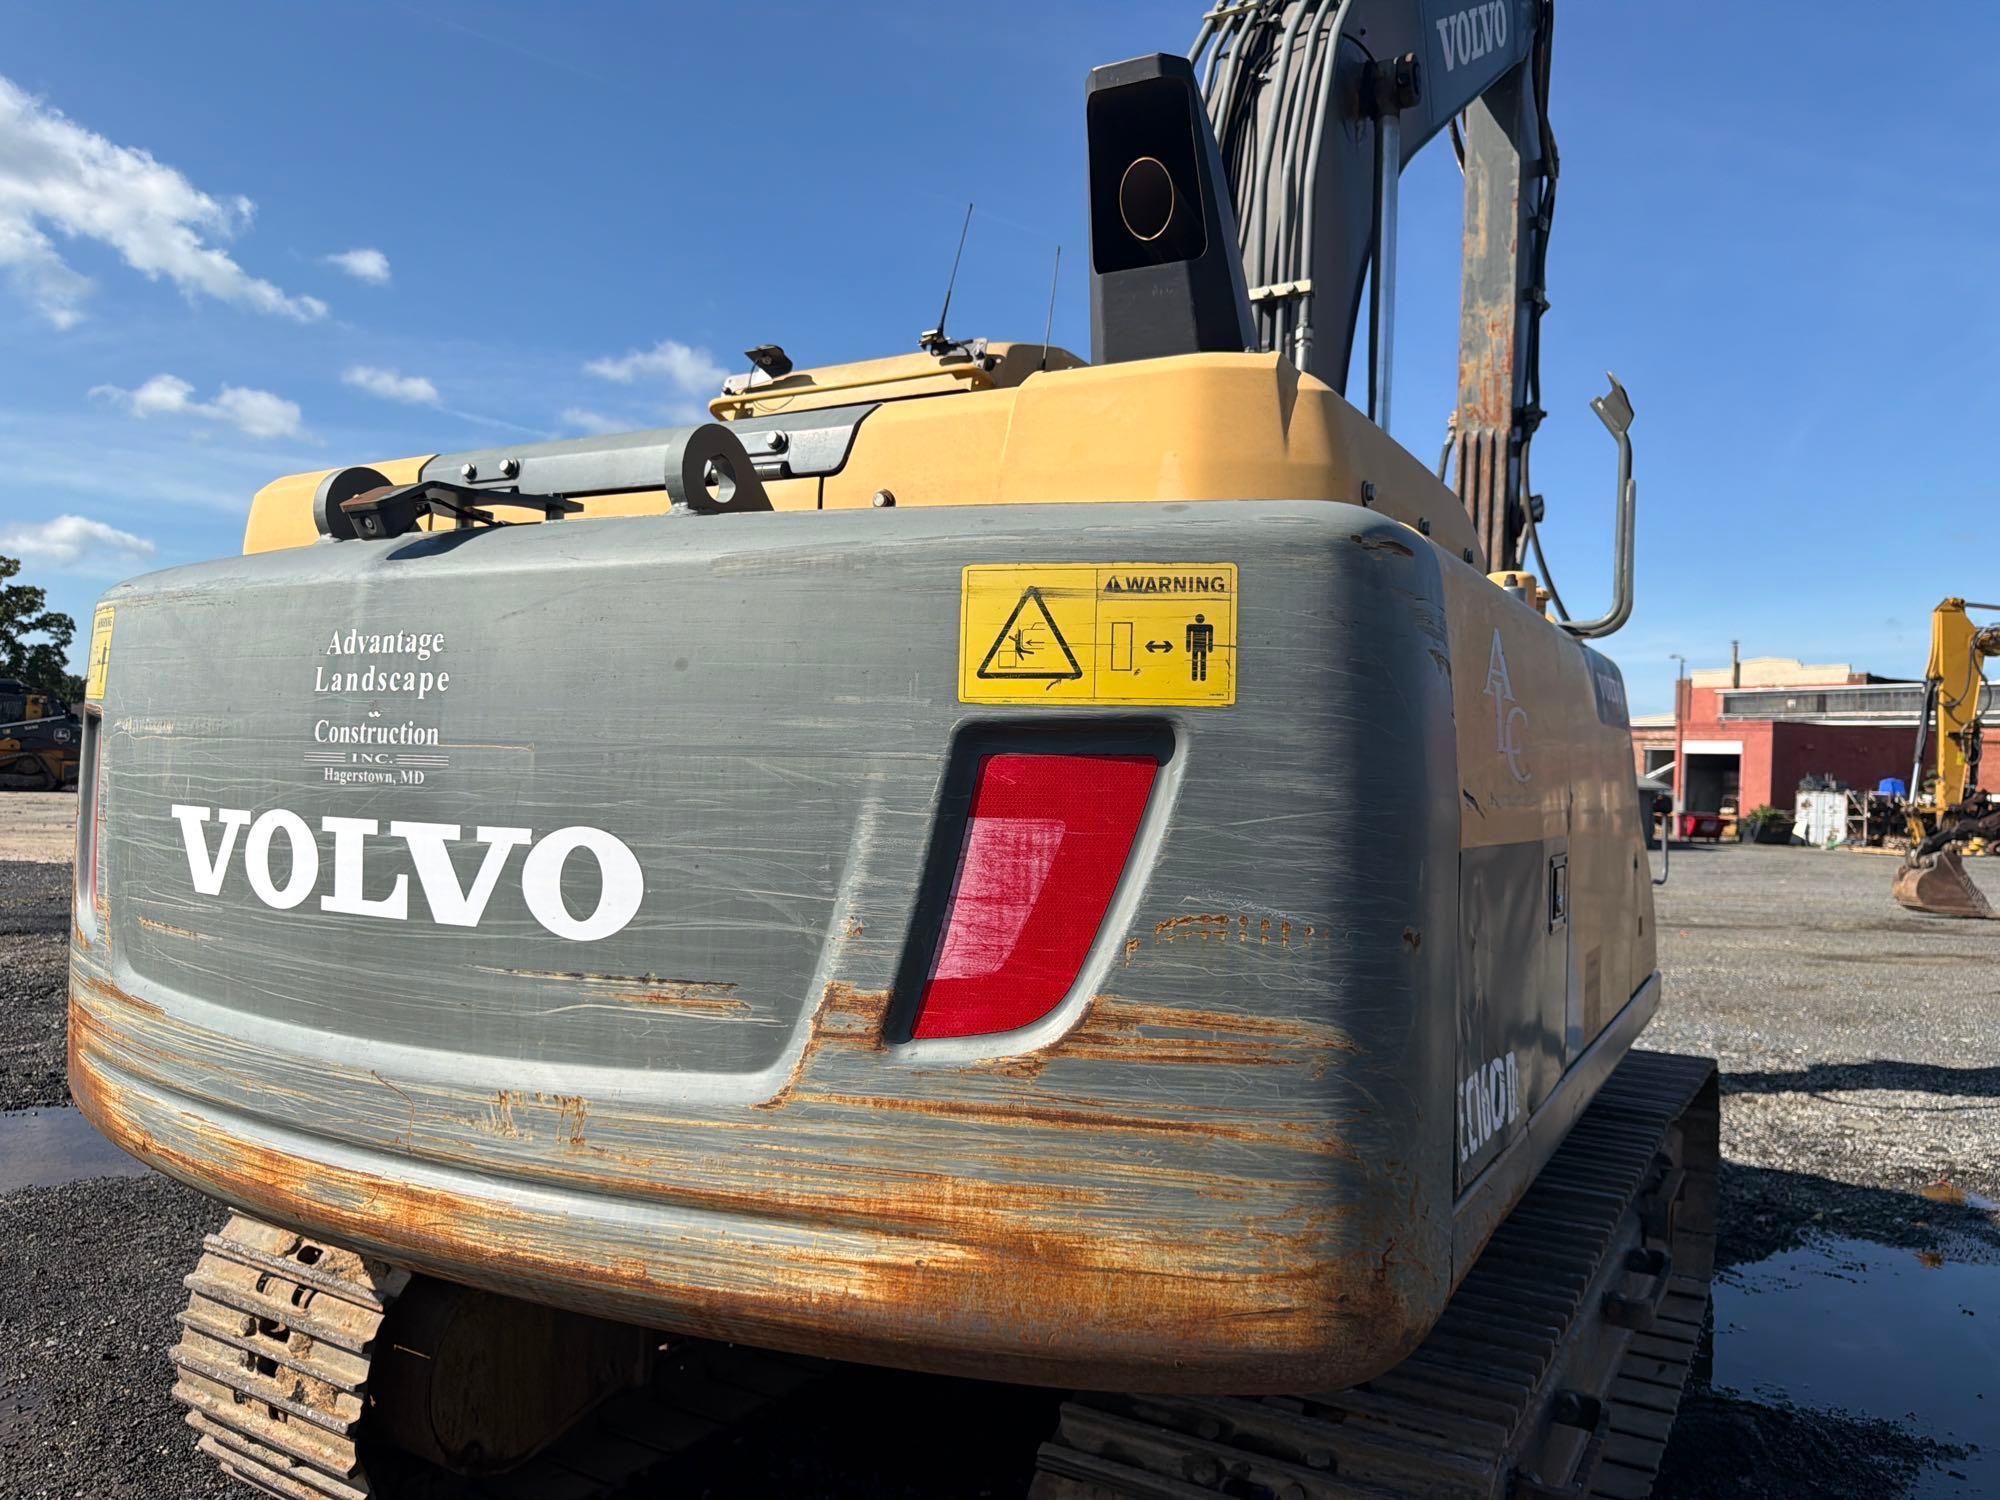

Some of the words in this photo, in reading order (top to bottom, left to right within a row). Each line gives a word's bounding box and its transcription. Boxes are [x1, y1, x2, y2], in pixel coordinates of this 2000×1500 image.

[1436, 0, 1507, 72] VOLVO
[1125, 576, 1226, 593] WARNING
[326, 628, 445, 661] Advantage
[314, 665, 450, 700] Landscape
[314, 719, 440, 746] Construction
[351, 753, 394, 765] INC.
[324, 767, 397, 785] Hagerstown,
[400, 770, 425, 785] MD
[171, 804, 645, 942] VOLVO
